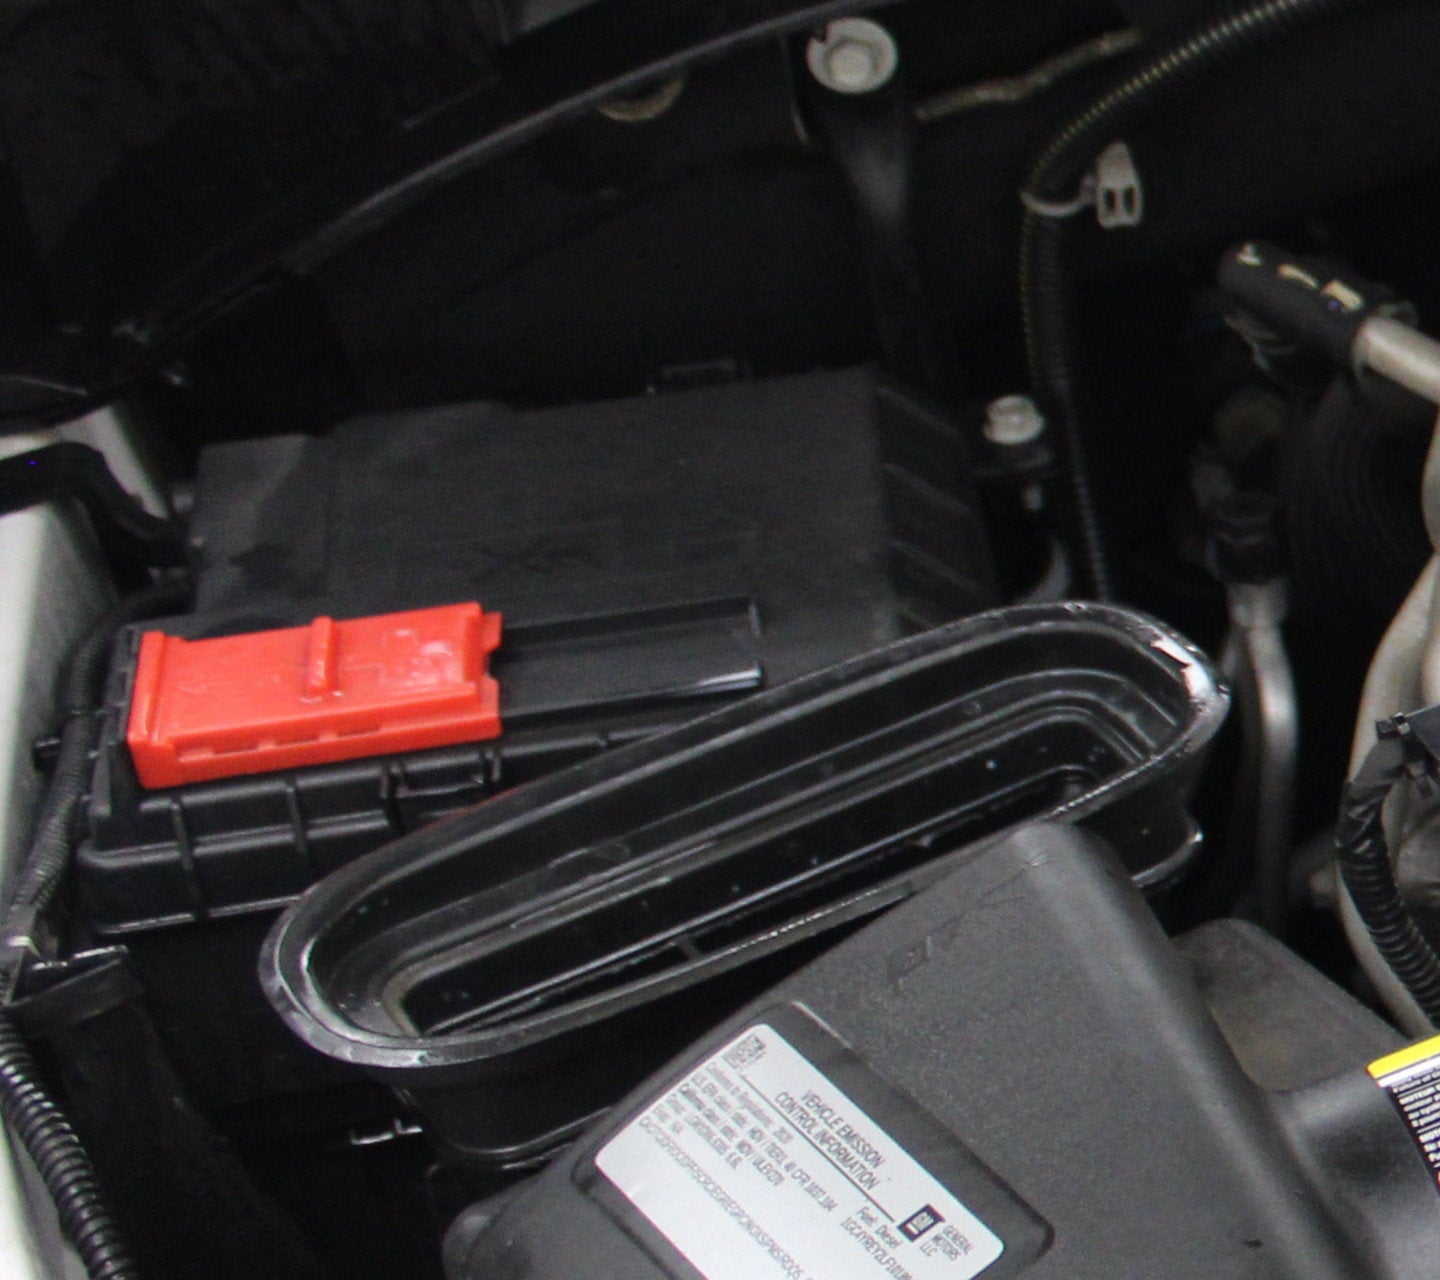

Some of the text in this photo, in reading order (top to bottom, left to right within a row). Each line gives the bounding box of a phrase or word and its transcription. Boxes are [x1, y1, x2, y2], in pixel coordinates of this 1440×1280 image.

[771, 1089, 823, 1136] CONTROL
[811, 1127, 882, 1192] INFORMATION
[798, 1089, 887, 1170] VEHICLE EMISSION
[872, 1223, 903, 1251] Diesel
[917, 1239, 939, 1258] LLC
[928, 1231, 963, 1263] MOTORS
[940, 1223, 976, 1256] GENERAL
